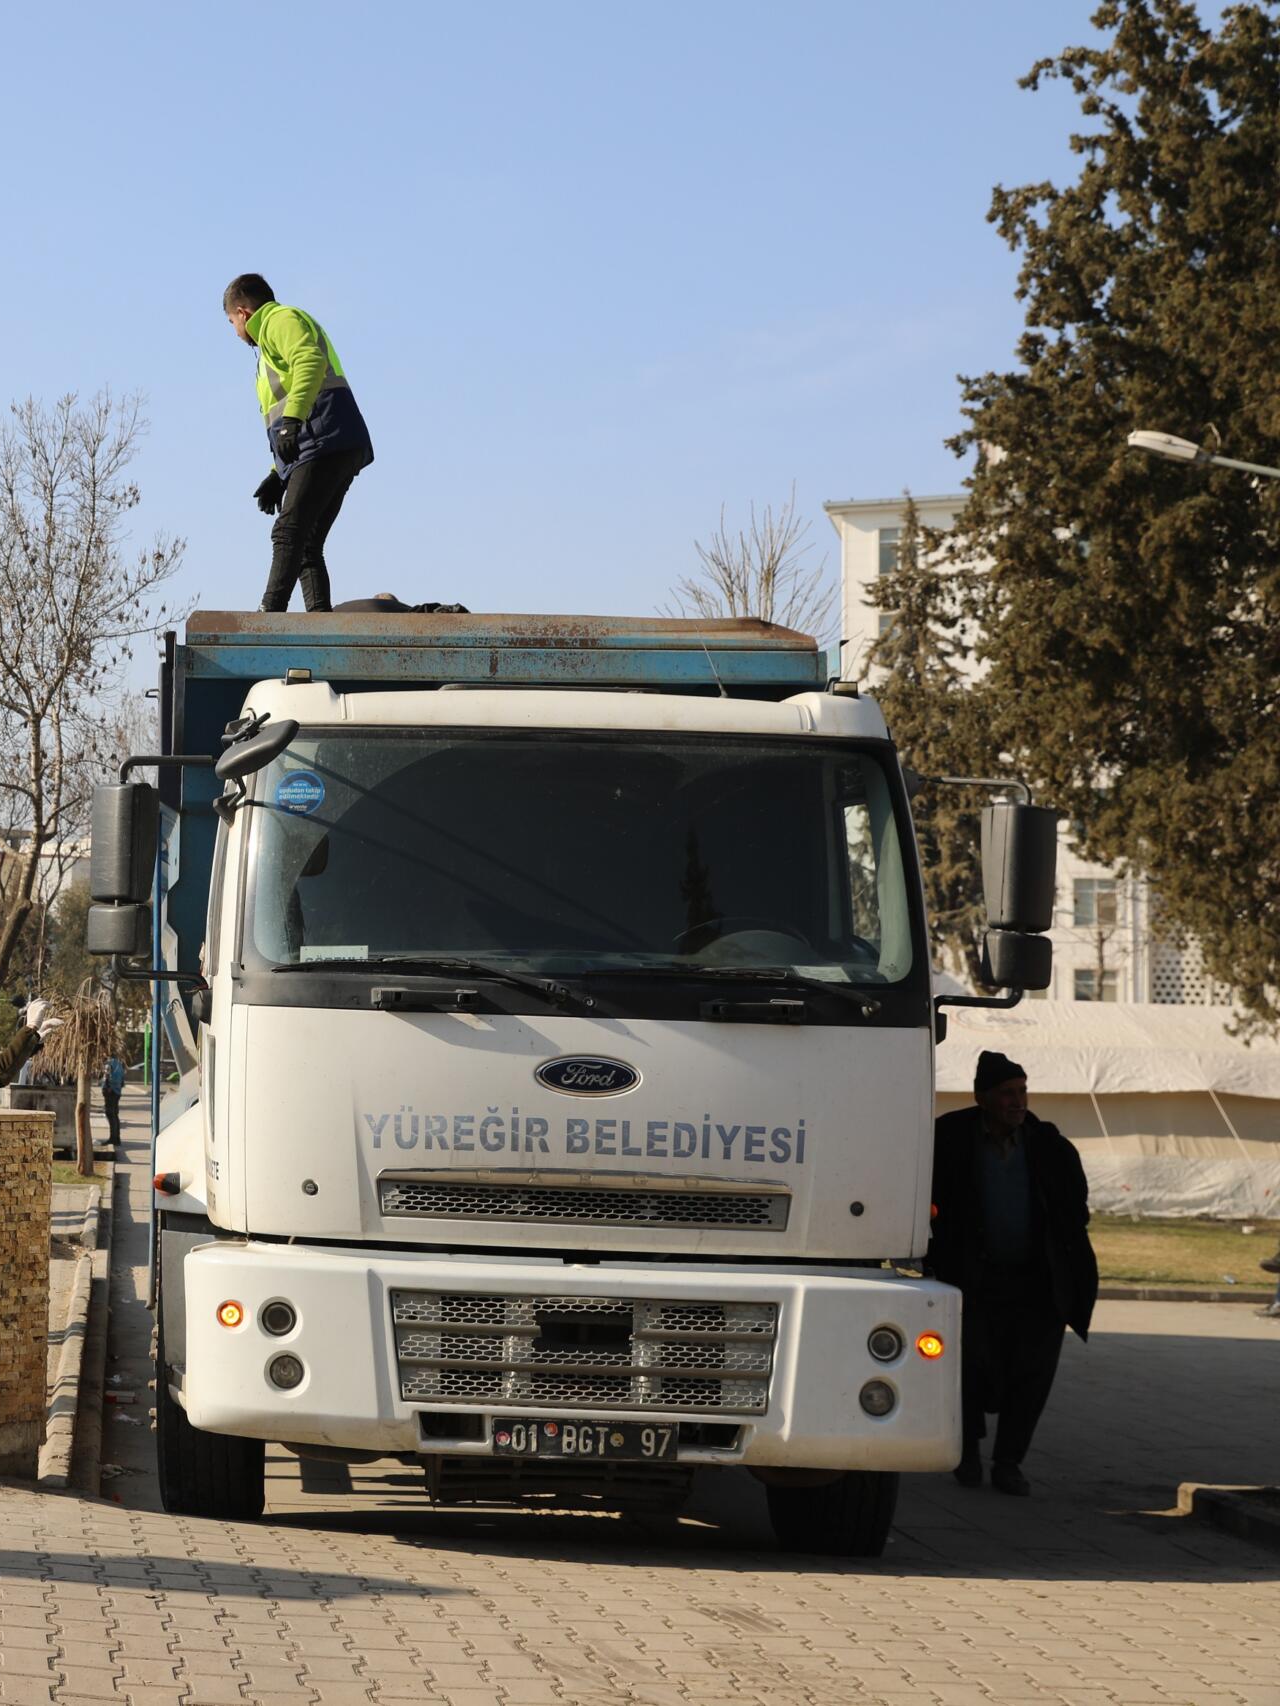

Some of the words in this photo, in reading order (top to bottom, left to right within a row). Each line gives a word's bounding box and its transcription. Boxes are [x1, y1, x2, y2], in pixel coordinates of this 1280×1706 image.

[561, 1063, 616, 1087] Ford
[363, 1106, 550, 1153] YÜREĞİR
[566, 1113, 807, 1164] BELEDİYESİ
[511, 1424, 538, 1452] 01
[562, 1425, 609, 1455] BGT
[640, 1428, 672, 1457] 97
